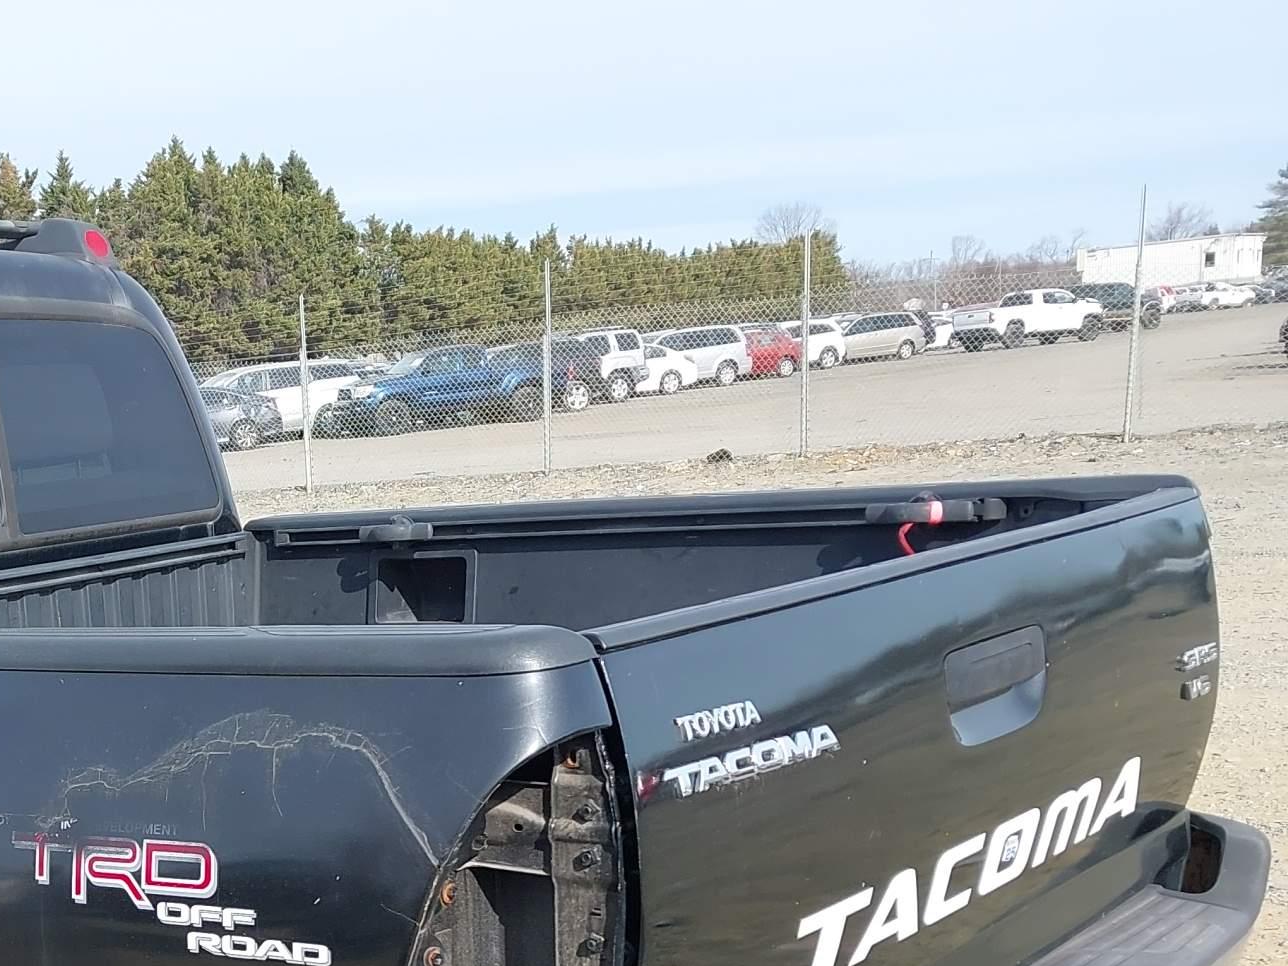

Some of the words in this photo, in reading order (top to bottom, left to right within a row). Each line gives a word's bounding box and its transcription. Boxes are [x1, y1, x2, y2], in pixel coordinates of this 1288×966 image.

[673, 700, 762, 742] TOYOTA
[663, 724, 841, 799] TACOMA
[12, 831, 218, 911] TRD
[156, 901, 257, 930] OFF
